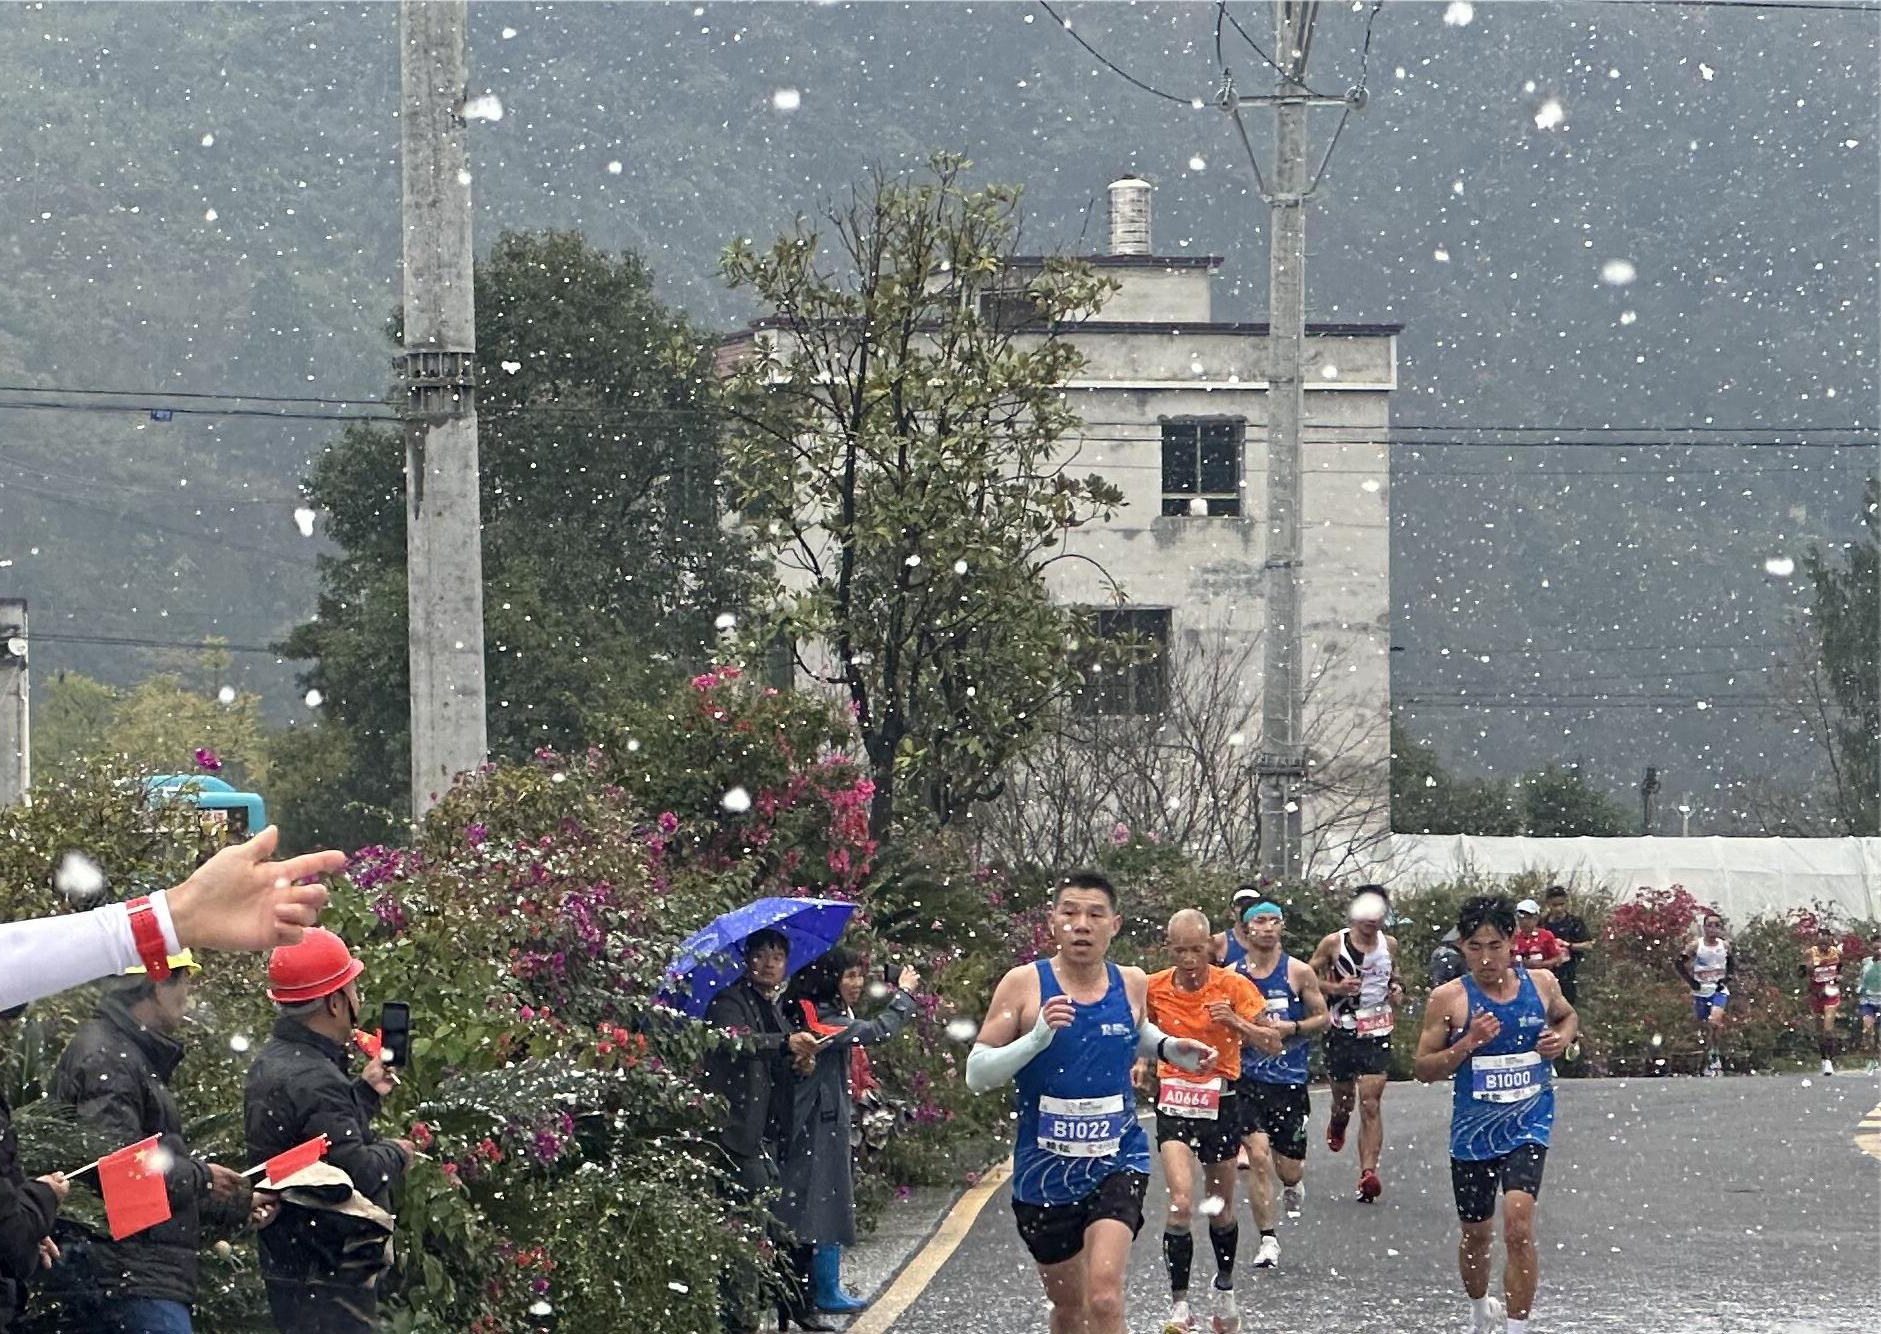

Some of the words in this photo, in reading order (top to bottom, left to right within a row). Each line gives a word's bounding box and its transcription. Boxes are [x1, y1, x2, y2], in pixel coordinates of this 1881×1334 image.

[1485, 1071, 1531, 1089] B1000
[1164, 1089, 1209, 1106] A0664
[1053, 1120, 1111, 1139] B1022
